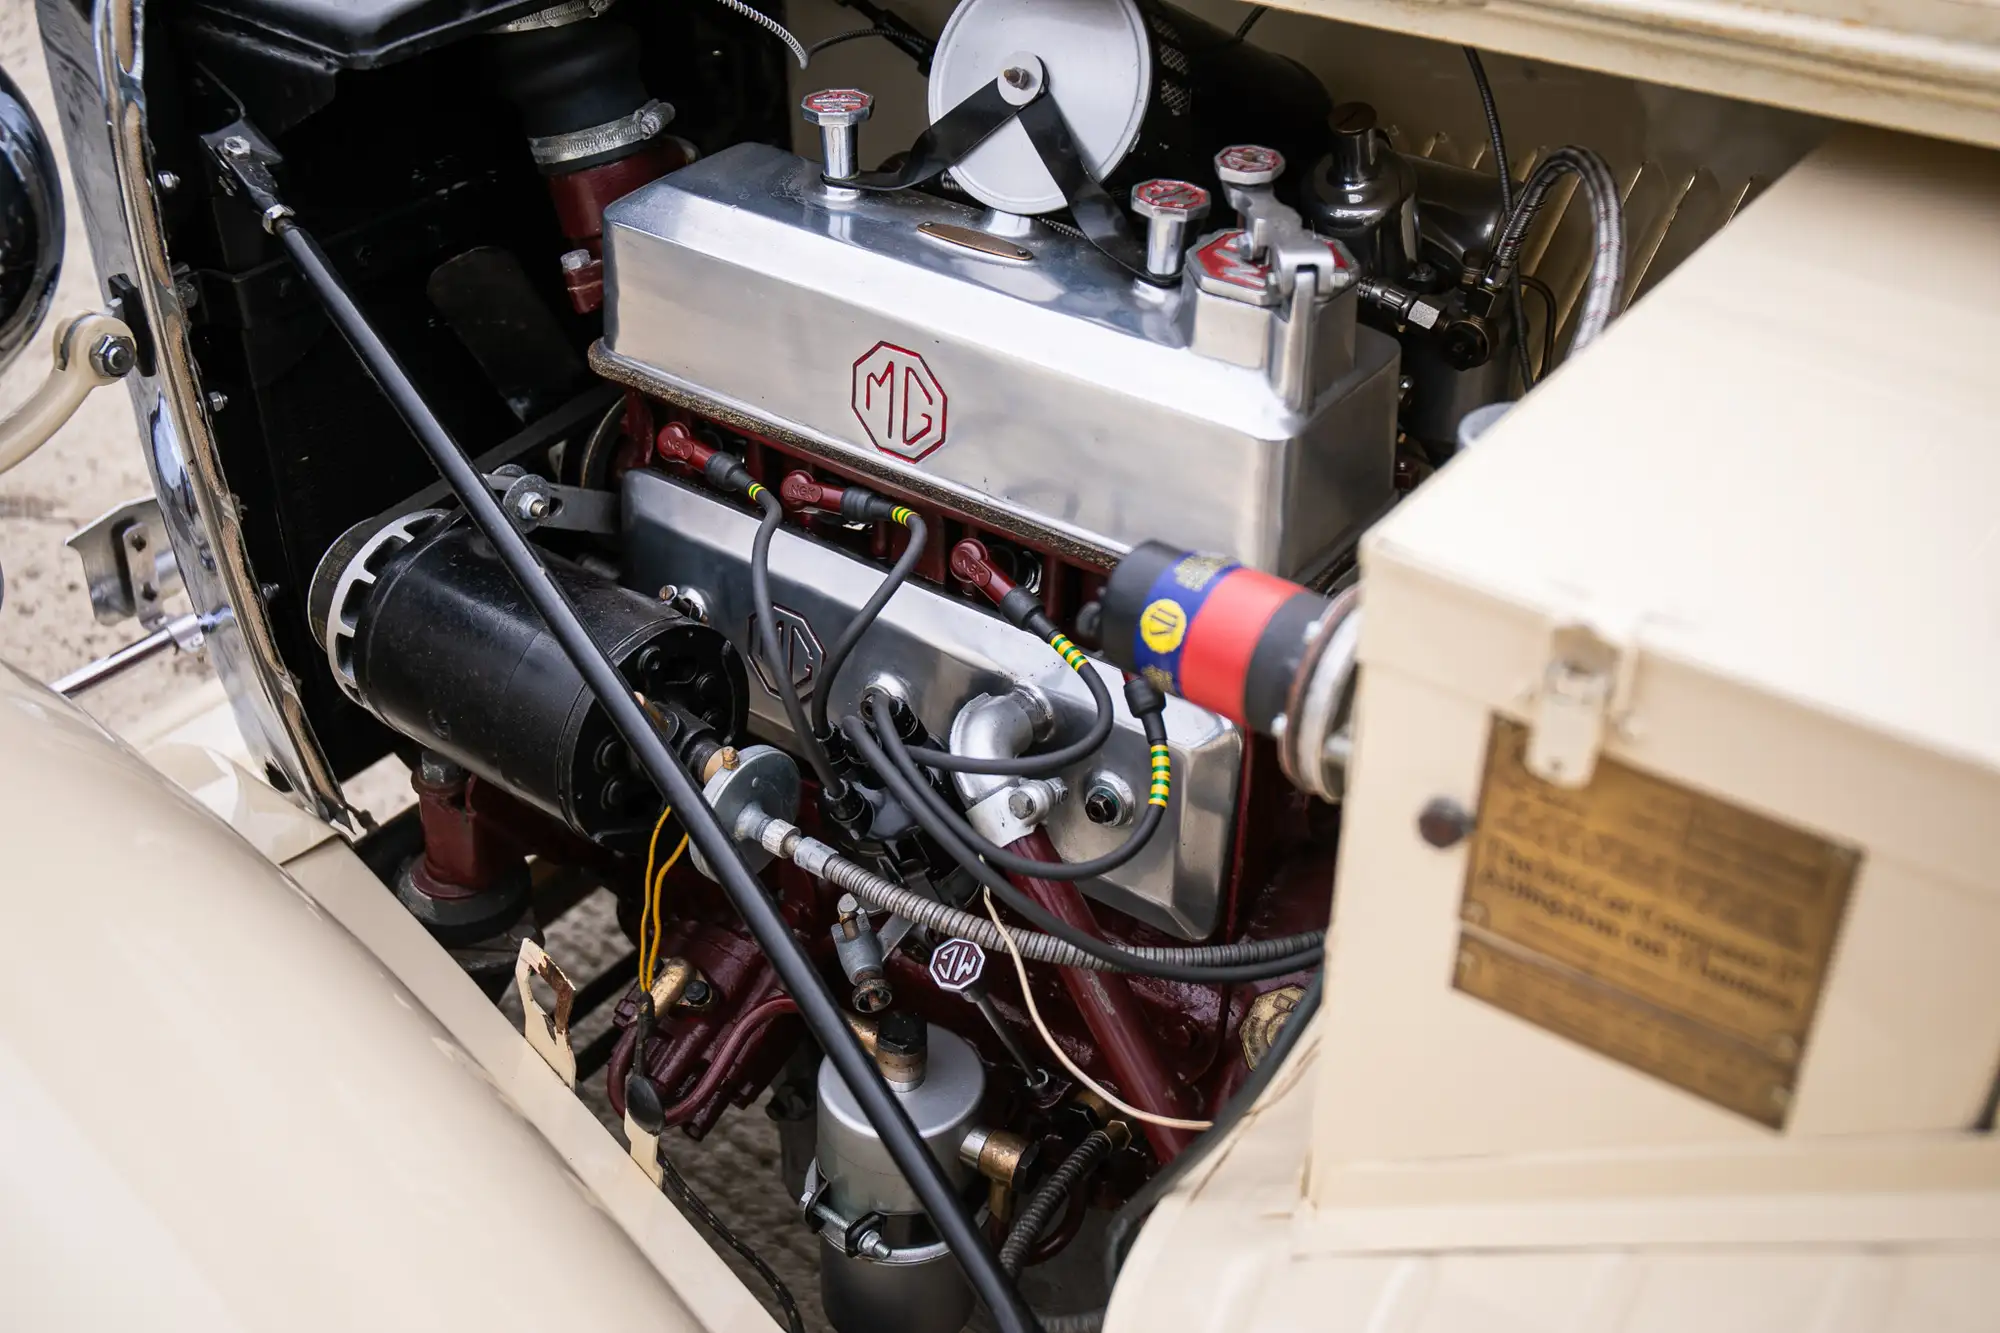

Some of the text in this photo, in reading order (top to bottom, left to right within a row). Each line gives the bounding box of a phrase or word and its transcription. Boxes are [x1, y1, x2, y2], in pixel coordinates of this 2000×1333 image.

[865, 360, 934, 446] MG
[786, 483, 816, 502] NGK
[936, 944, 977, 982] MG
